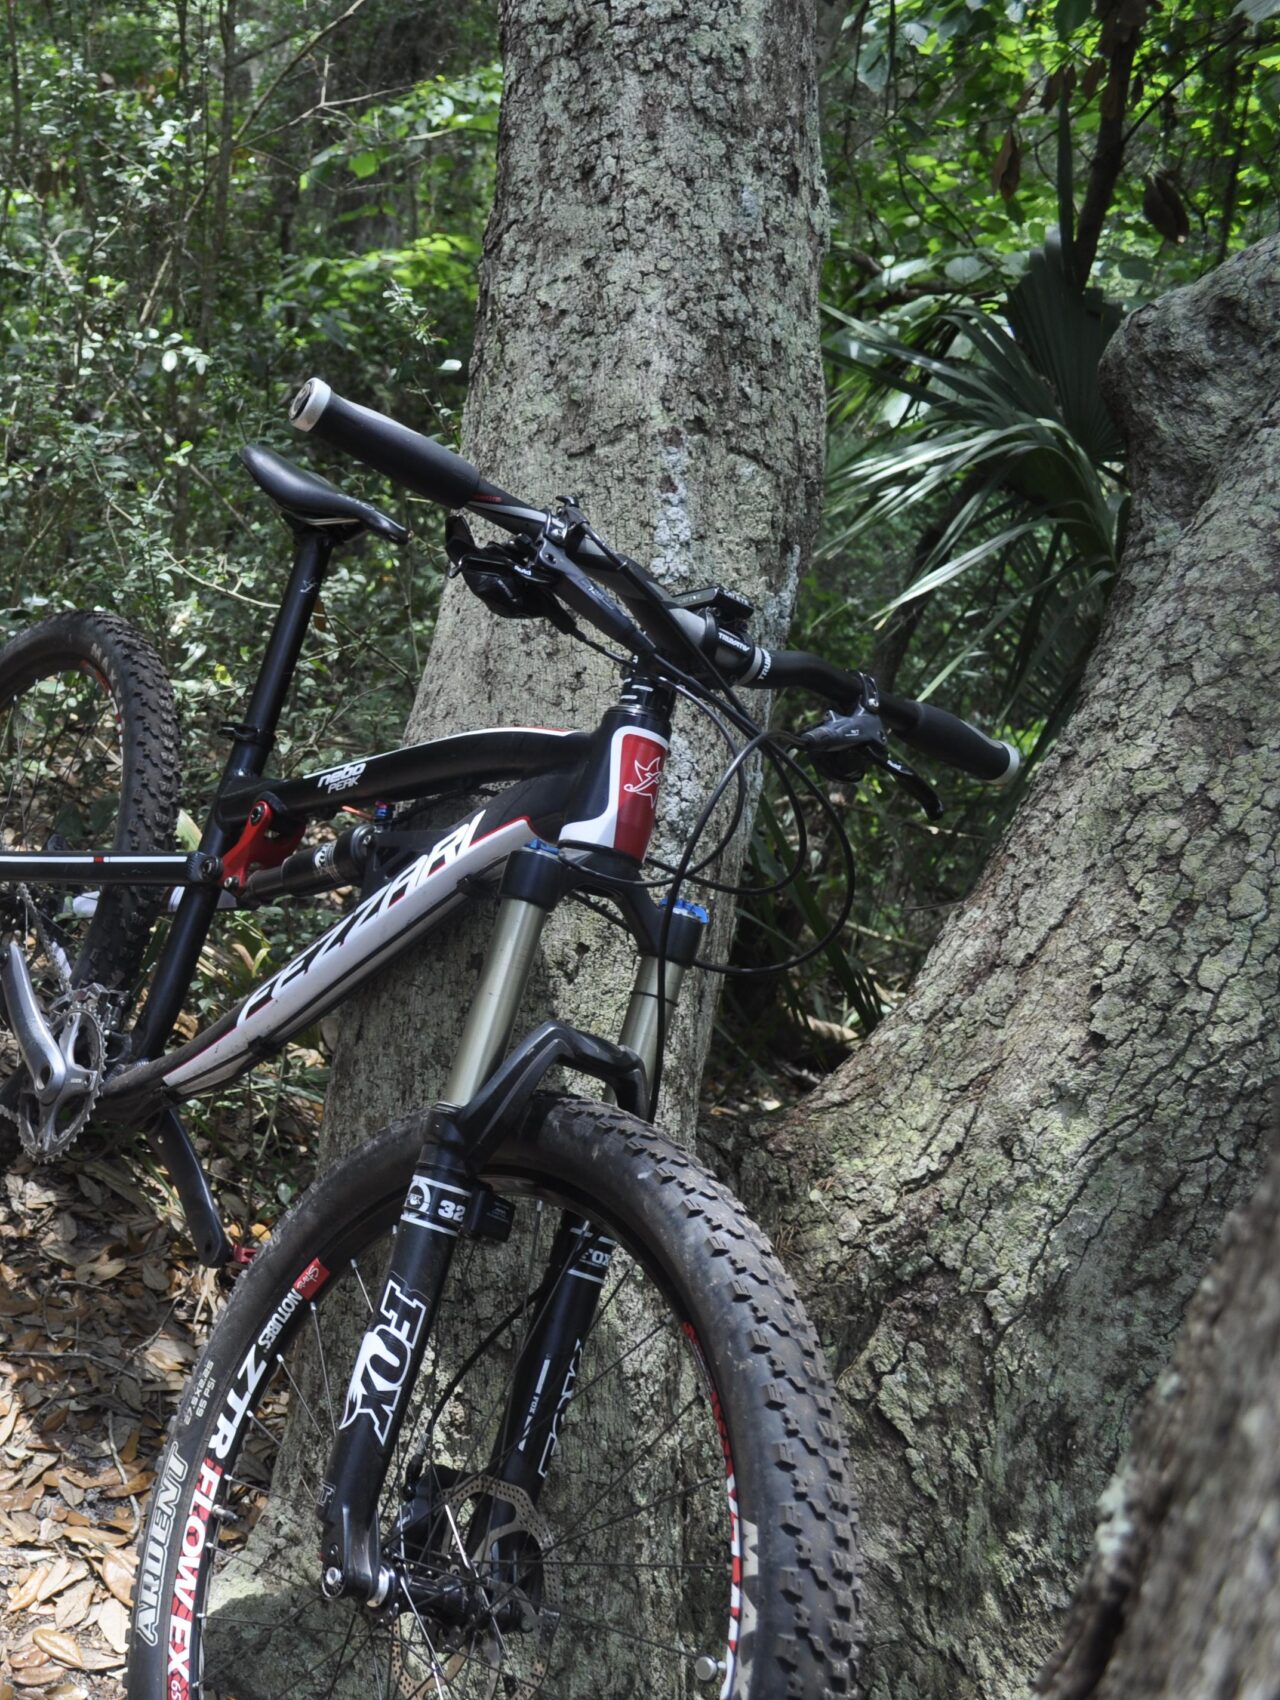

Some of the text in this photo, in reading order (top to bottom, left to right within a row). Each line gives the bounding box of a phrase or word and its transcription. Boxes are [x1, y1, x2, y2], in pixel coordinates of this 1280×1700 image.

[317, 762, 367, 788] nebo
[327, 774, 362, 794] PEAK
[236, 809, 487, 1029] FEZZARI
[437, 1199, 466, 1222] 32
[257, 1287, 304, 1350] NOTUBES
[203, 1376, 218, 1399] PSI
[338, 1278, 427, 1447] FOX
[208, 1343, 268, 1459] ZTR
[136, 1440, 189, 1647] ARDENT
[174, 1461, 222, 1612] FLOW
[167, 1614, 192, 1683] EX
